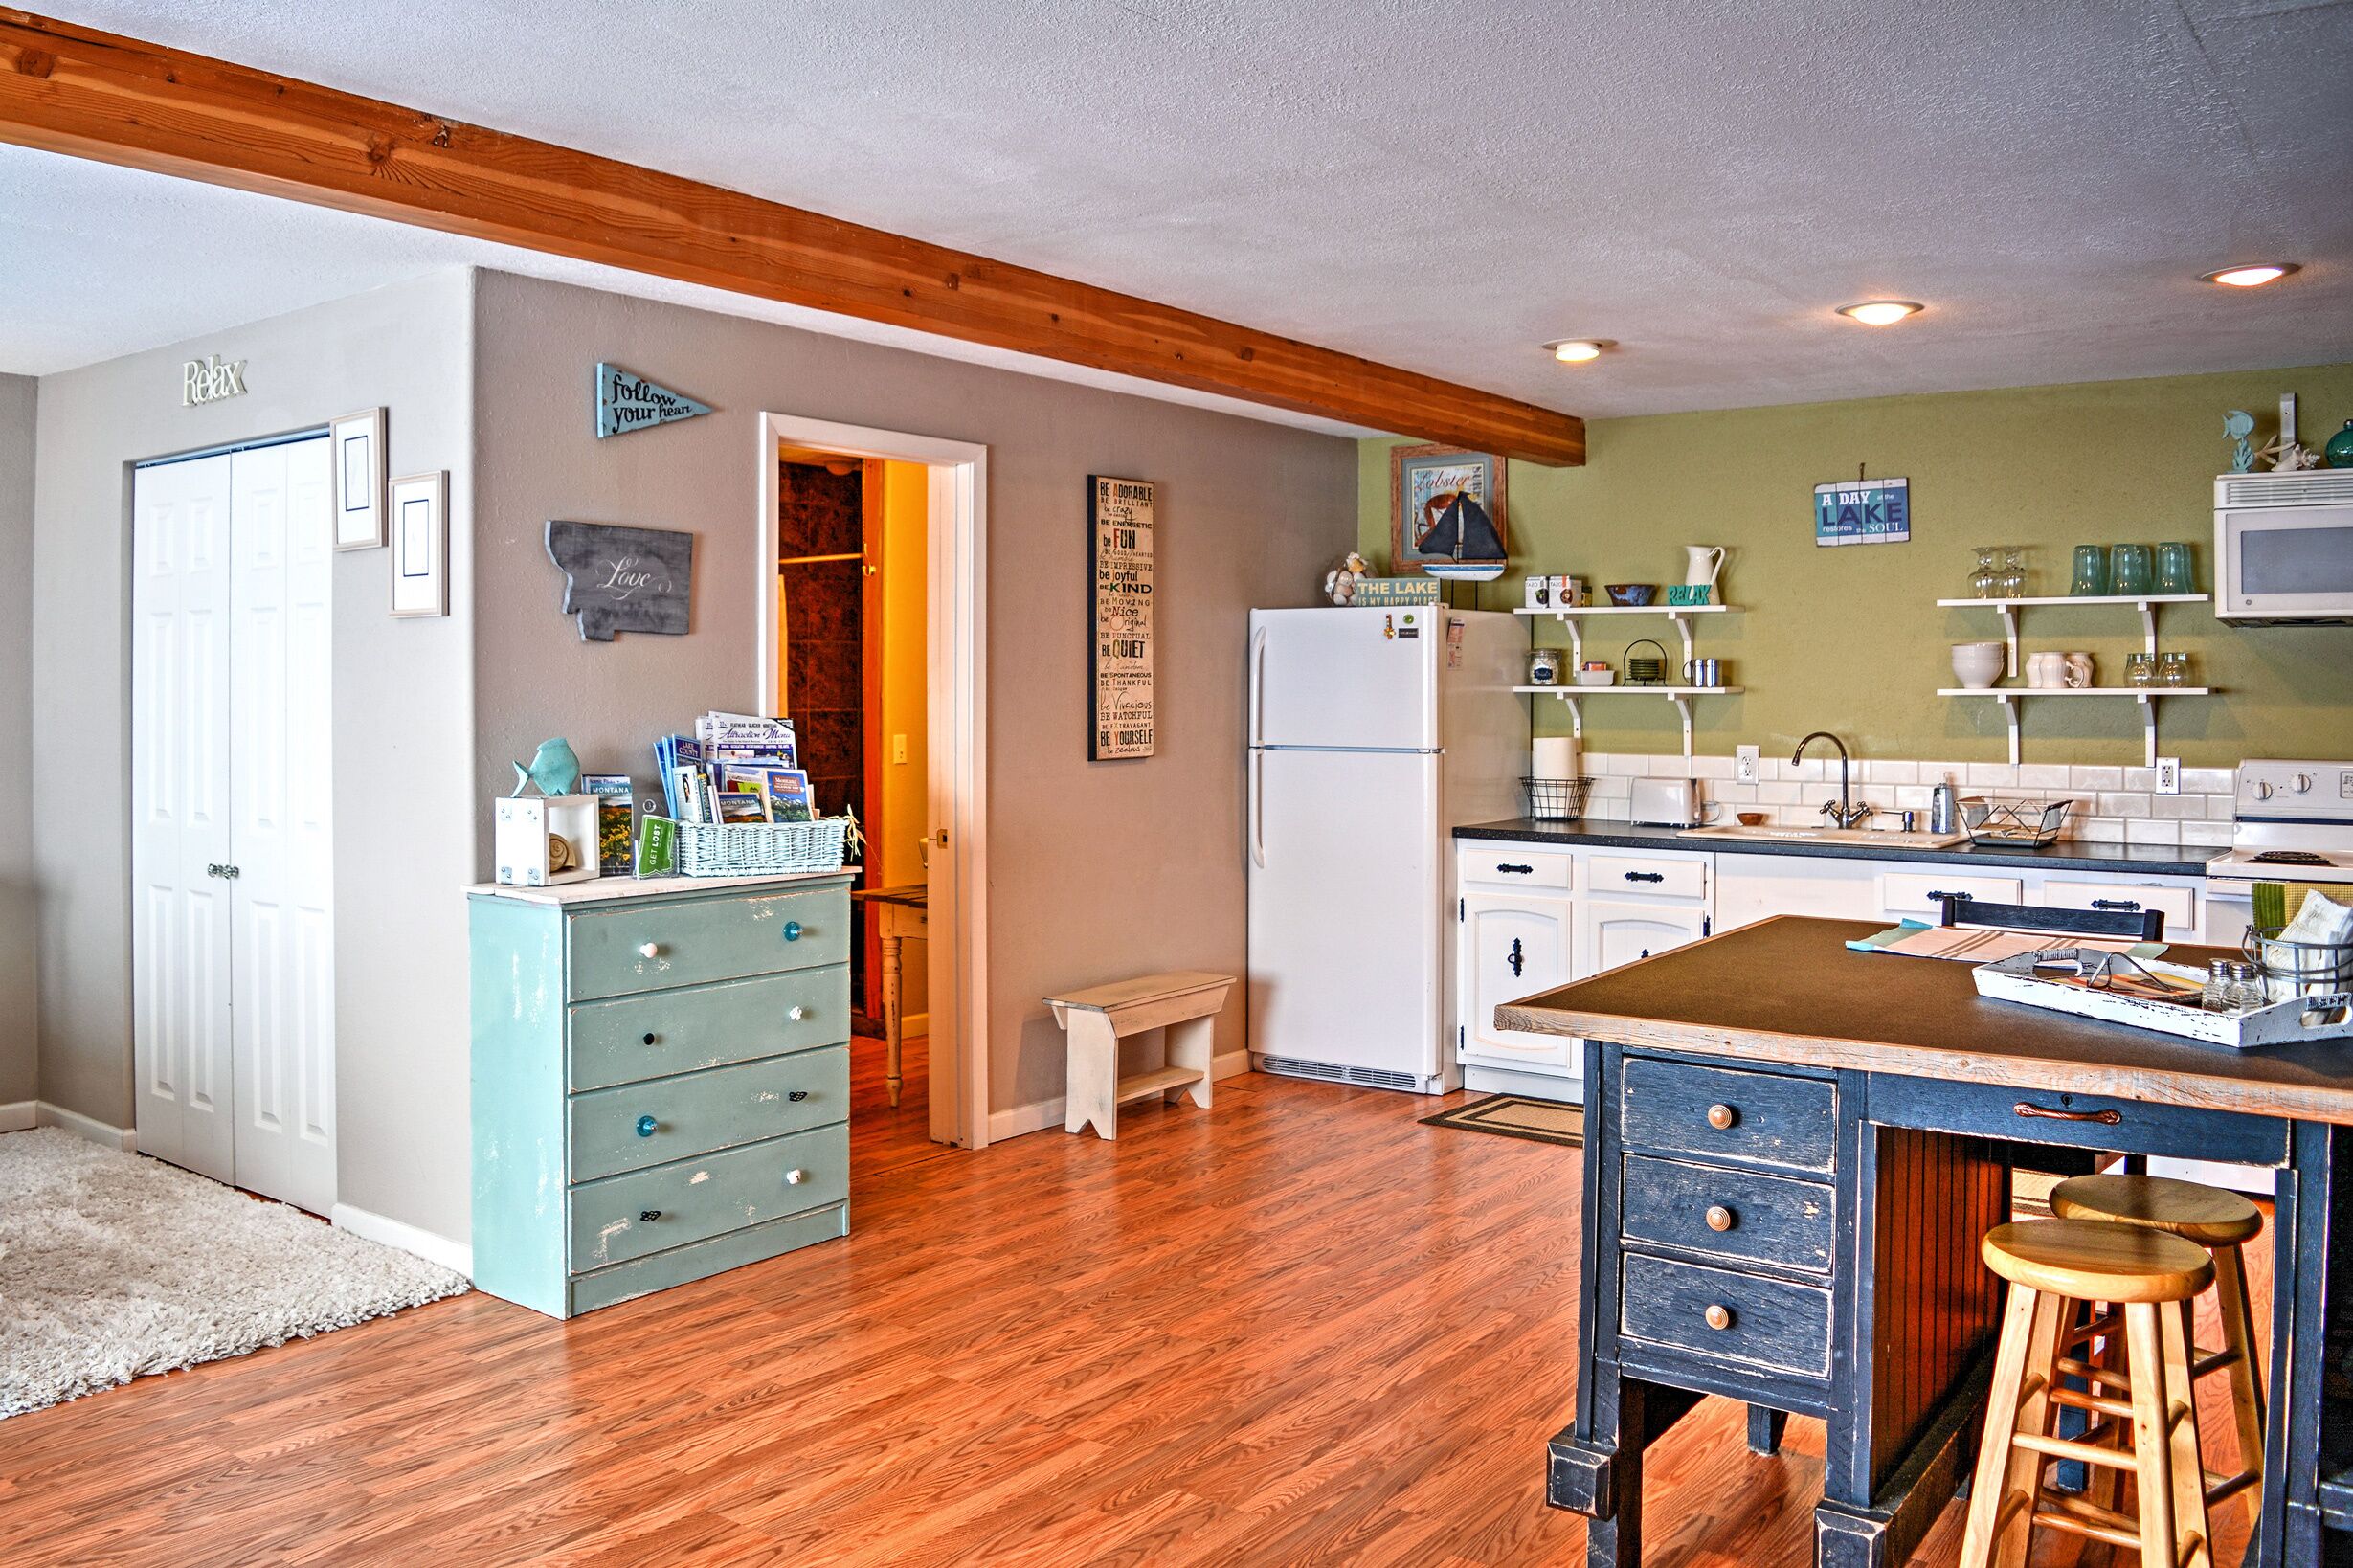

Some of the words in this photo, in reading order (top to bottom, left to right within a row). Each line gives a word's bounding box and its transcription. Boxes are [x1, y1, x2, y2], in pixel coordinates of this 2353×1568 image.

[182, 354, 245, 407] Relax
[613, 374, 676, 406] follow
[613, 405, 656, 433] your
[658, 404, 693, 418] heart
[1415, 470, 1470, 491] Lobster
[1100, 482, 1109, 497] BE
[1113, 483, 1153, 501] ADORABLE
[1114, 499, 1153, 507] BRILLIANT
[1822, 494, 1833, 506] A
[1839, 491, 1871, 505] DAY
[1822, 502, 1902, 526] LAKE
[1113, 520, 1153, 528] ENERGETIC
[1823, 524, 1852, 533] restores
[1869, 522, 1903, 533] SOUL
[1103, 533, 1111, 547] be
[1113, 528, 1135, 549] FUN
[1110, 561, 1153, 571] IMPRESSIVE
[595, 556, 652, 594] Love
[1099, 569, 1110, 580] be
[1110, 582, 1152, 594] KIND
[1357, 582, 1390, 594] THE
[1395, 581, 1438, 594] LAKE
[1112, 597, 1150, 606] MOVING
[1359, 597, 1367, 606] IS
[1370, 597, 1380, 606] MY
[1384, 596, 1410, 606] HAPPY
[1413, 596, 1438, 605] PLACE
[1111, 606, 1139, 616] Nice
[1102, 644, 1111, 657] BE
[1112, 638, 1145, 659] QUIET
[1100, 712, 1110, 721] BE
[1112, 711, 1153, 720] WATCHFUL
[718, 728, 760, 739] Attraction
[763, 728, 791, 739] Menu
[1101, 731, 1110, 746] BE
[1114, 729, 1153, 746] YOURSELF
[682, 741, 694, 750] LAKE
[679, 747, 698, 757] COUNTY
[652, 824, 661, 847] LOST
